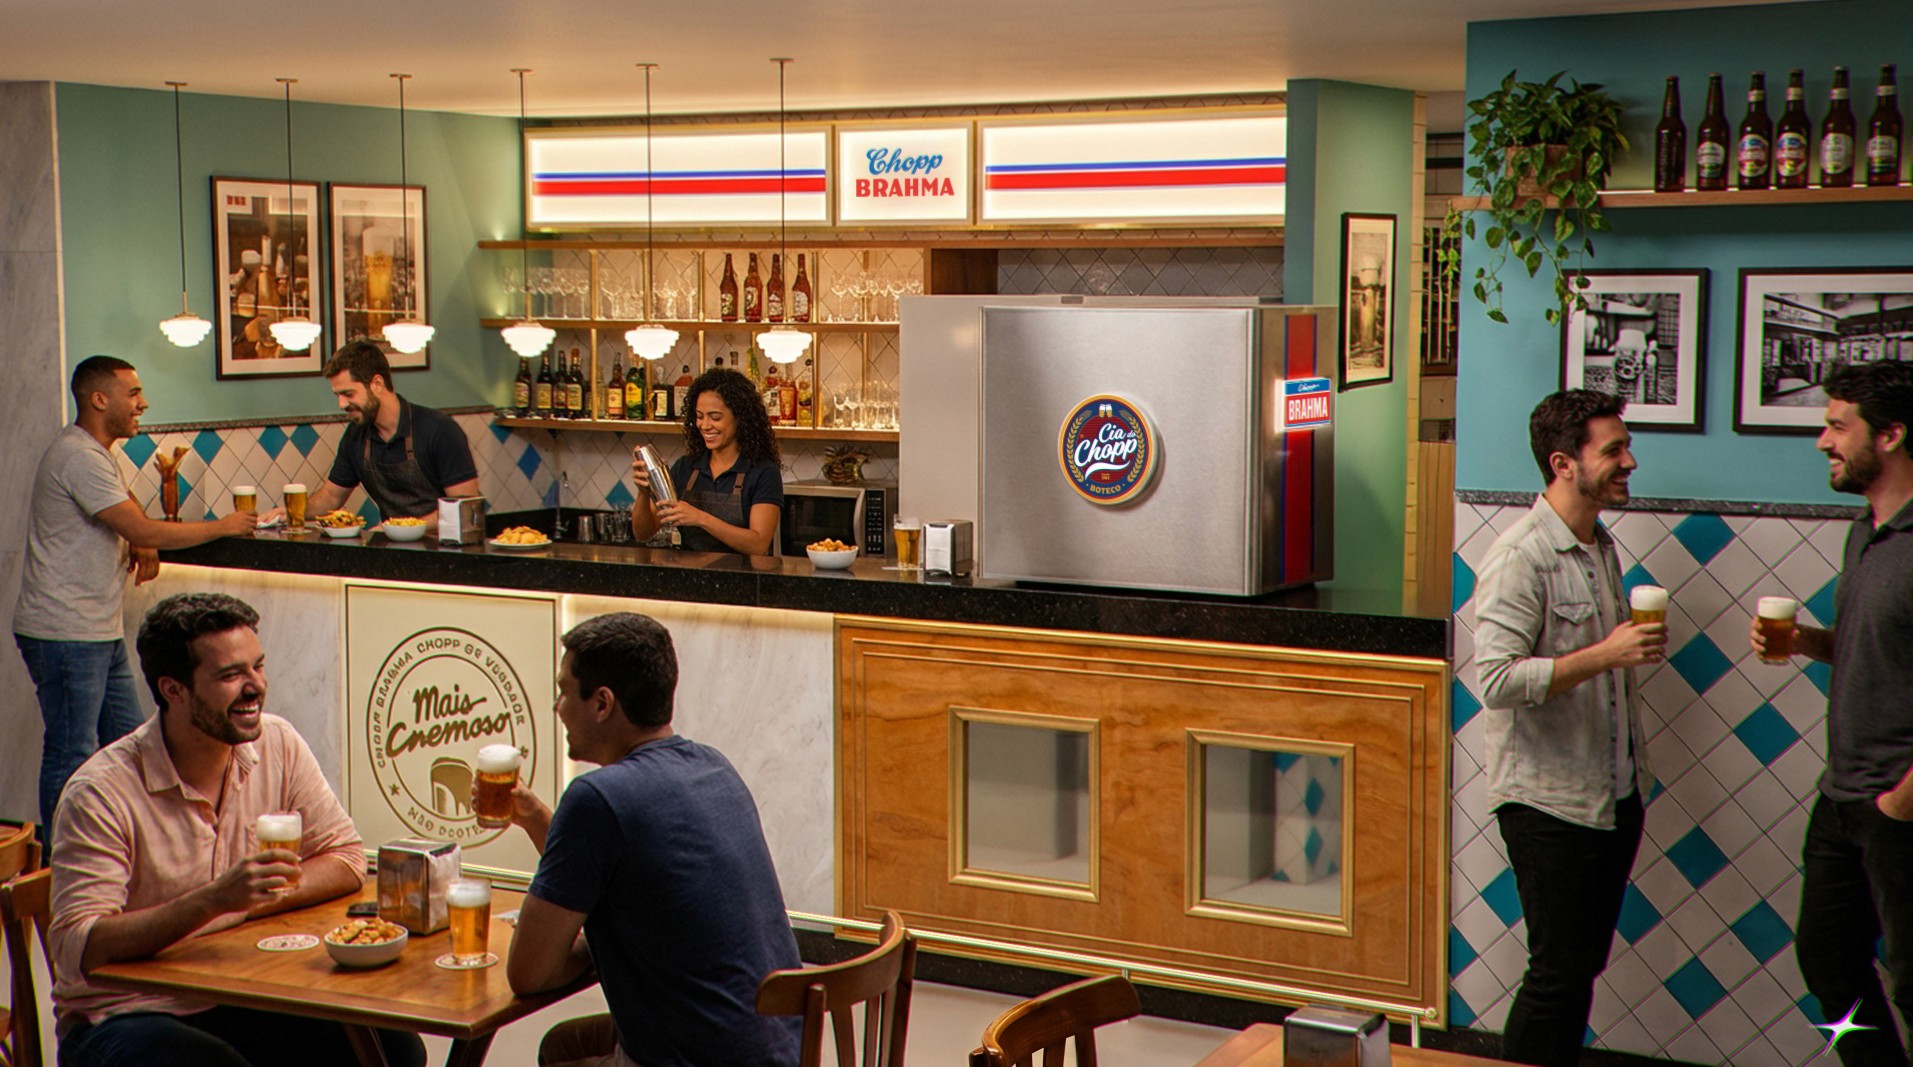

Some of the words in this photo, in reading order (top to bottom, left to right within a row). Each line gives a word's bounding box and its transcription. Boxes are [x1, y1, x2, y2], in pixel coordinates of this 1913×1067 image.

[866, 148, 943, 175] Chopp
[855, 177, 955, 198] BRAHMA
[1288, 397, 1328, 421] BRAHMA
[1098, 422, 1126, 444] Cia
[1074, 437, 1138, 467] Chopp
[1089, 484, 1121, 495] BOTECO
[416, 638, 461, 654] CHOPP
[412, 683, 487, 724] Mais
[385, 711, 511, 757] Cremoso
